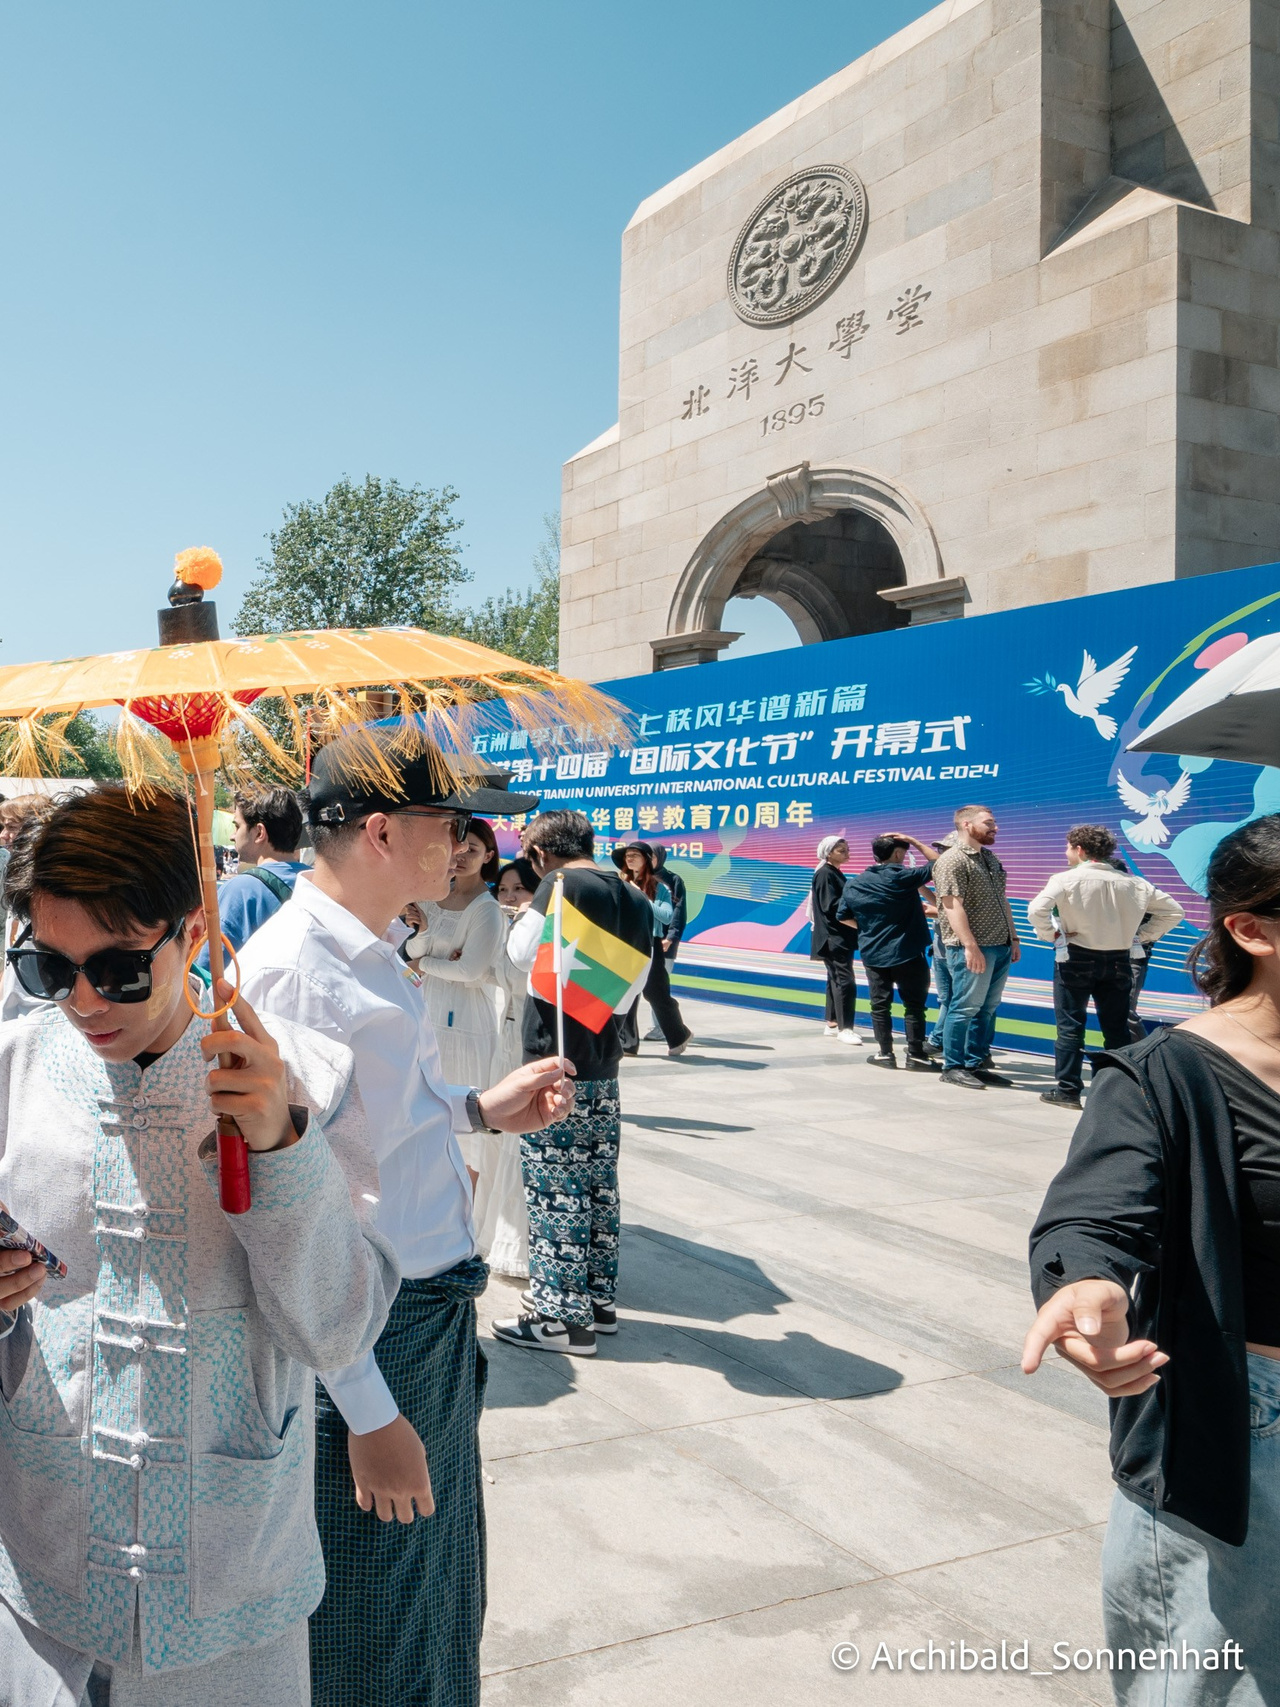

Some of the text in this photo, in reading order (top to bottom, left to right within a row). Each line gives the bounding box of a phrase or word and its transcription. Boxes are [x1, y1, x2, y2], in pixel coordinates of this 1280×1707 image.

[681, 284, 933, 421] 北洋大學堂
[760, 393, 826, 437] 1895
[639, 684, 868, 735] 七秩风华谱新篇
[543, 787, 584, 800] TIANJIN
[585, 783, 654, 798] UNIVERSITY
[654, 776, 765, 795] INTERNATIONAL
[767, 771, 850, 788] CULTURAL
[853, 766, 935, 784] FESTIVAL
[939, 764, 999, 780] 2024
